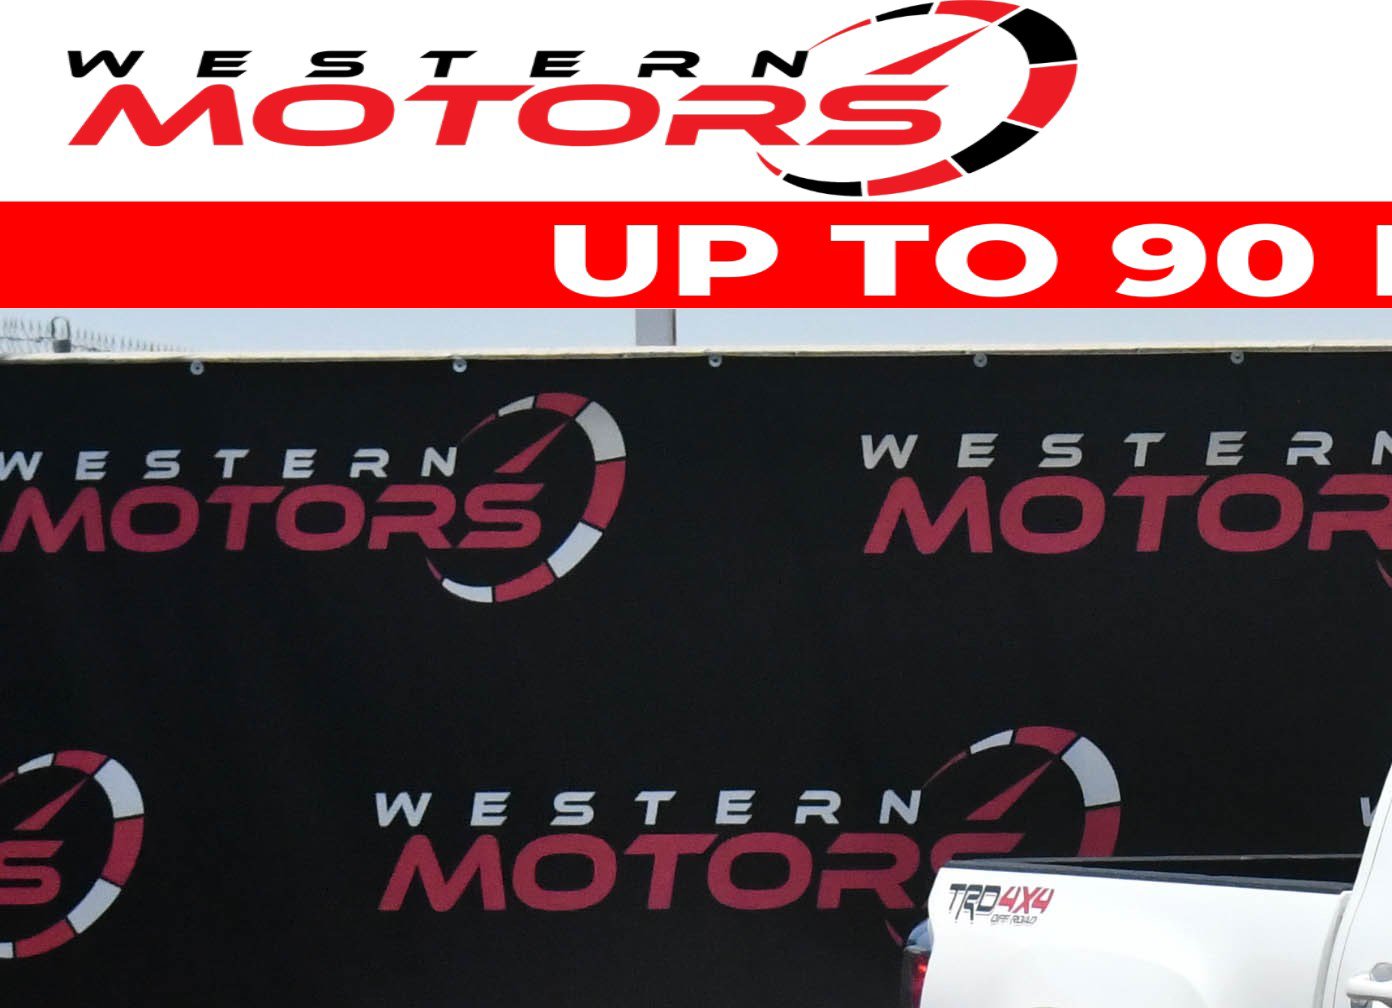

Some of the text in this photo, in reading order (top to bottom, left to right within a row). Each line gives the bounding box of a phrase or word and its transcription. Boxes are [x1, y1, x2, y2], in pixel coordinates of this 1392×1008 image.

[0, 446, 458, 481] WESTERN
[0, 483, 545, 553] MOTORS
[375, 790, 922, 827] WESTERN
